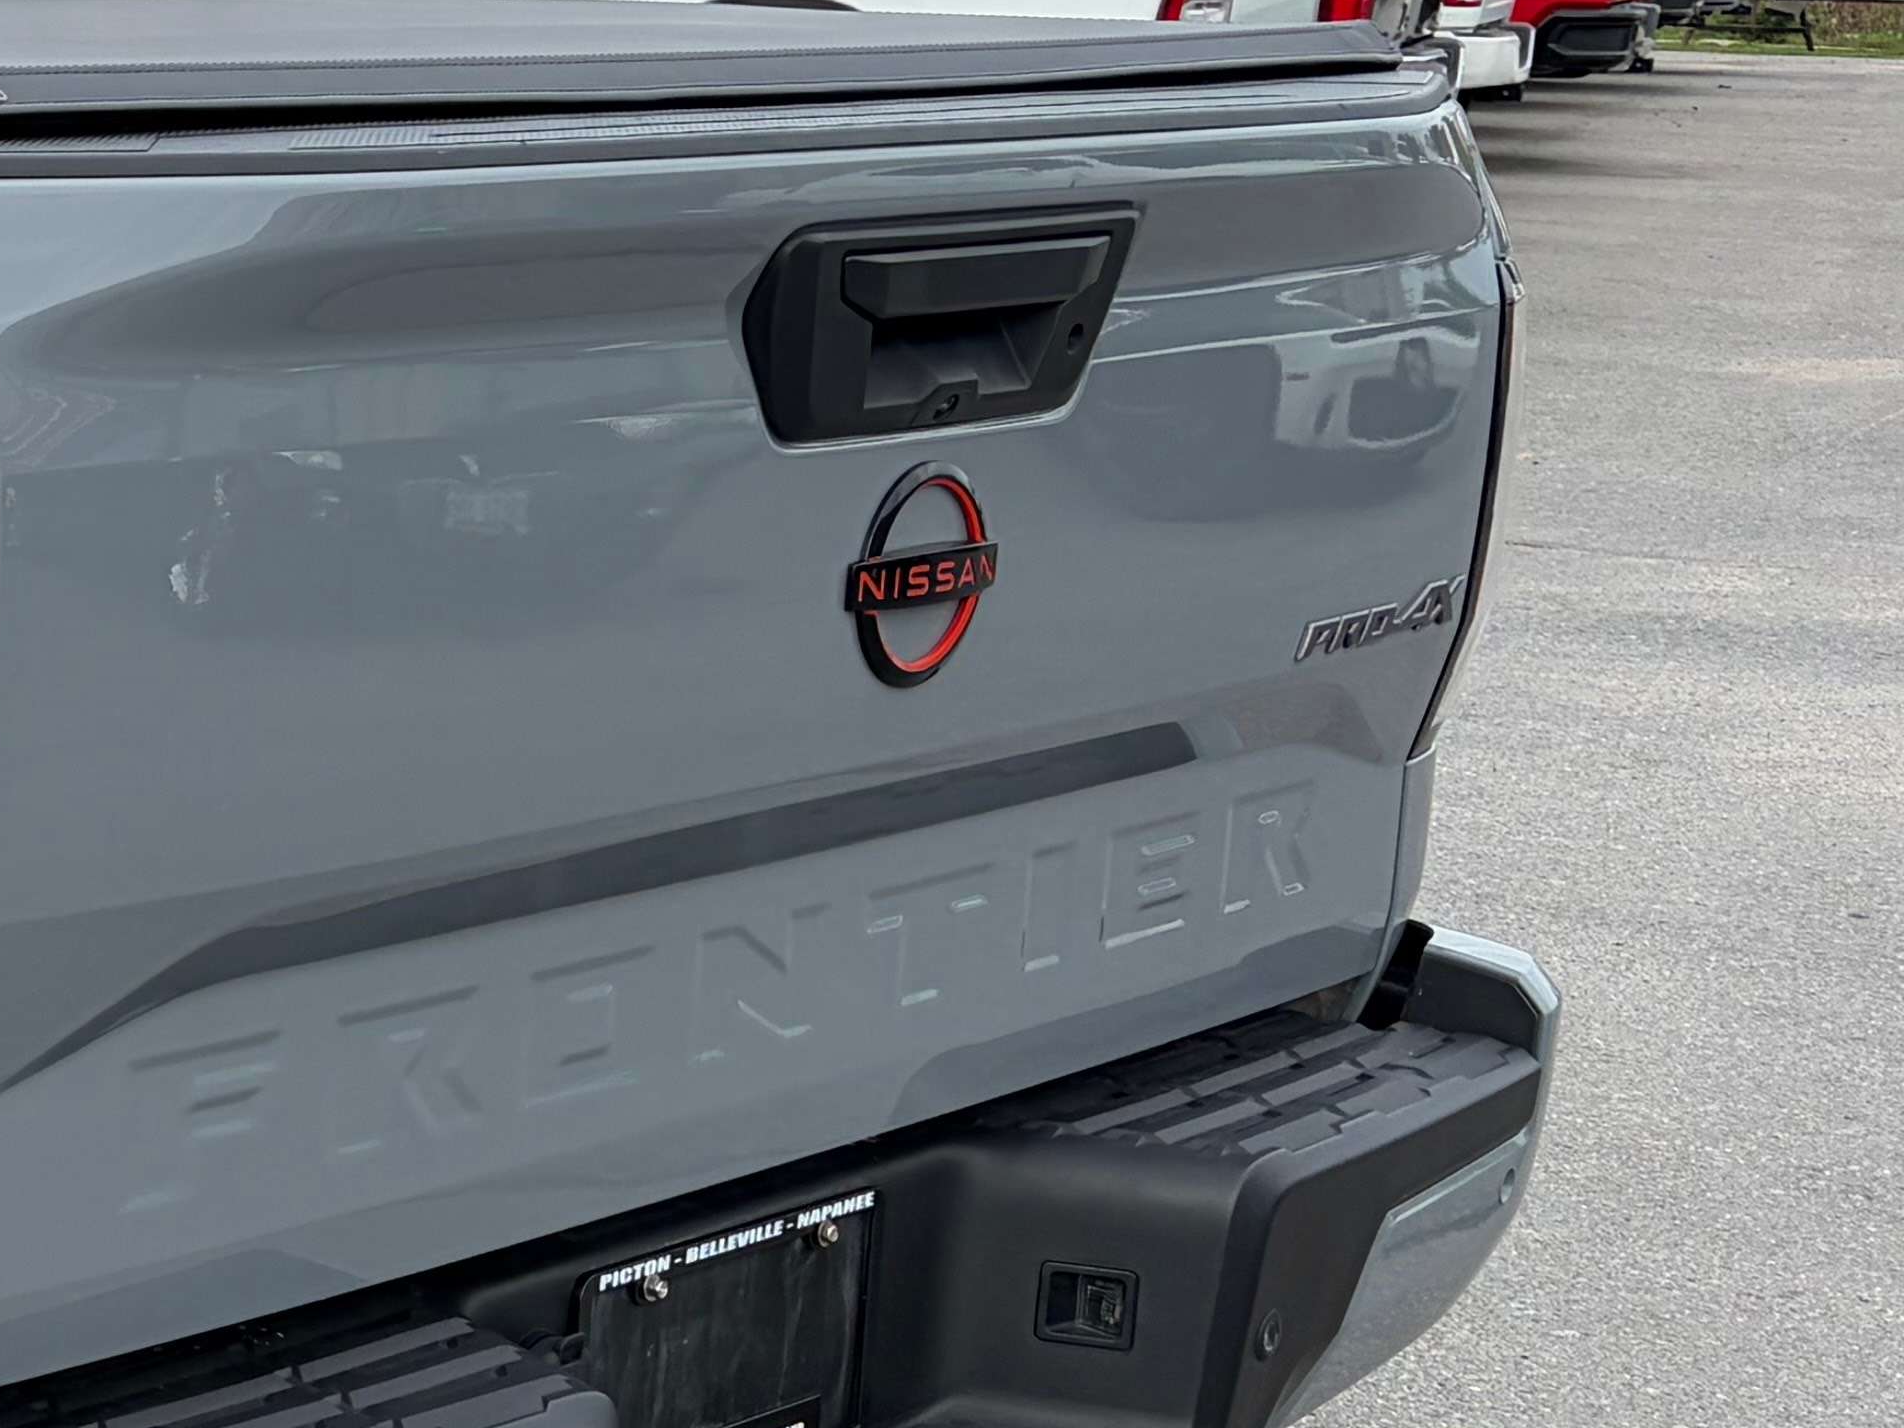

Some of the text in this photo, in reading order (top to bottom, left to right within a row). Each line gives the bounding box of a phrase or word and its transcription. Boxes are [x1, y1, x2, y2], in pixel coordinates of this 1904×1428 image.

[855, 550, 995, 604] NISSAN
[120, 778, 1318, 1214] FRONTIER
[599, 1254, 671, 1292] PICTON
[685, 1220, 785, 1264] BELLEVILLE
[797, 1191, 876, 1230] NAPANEE
